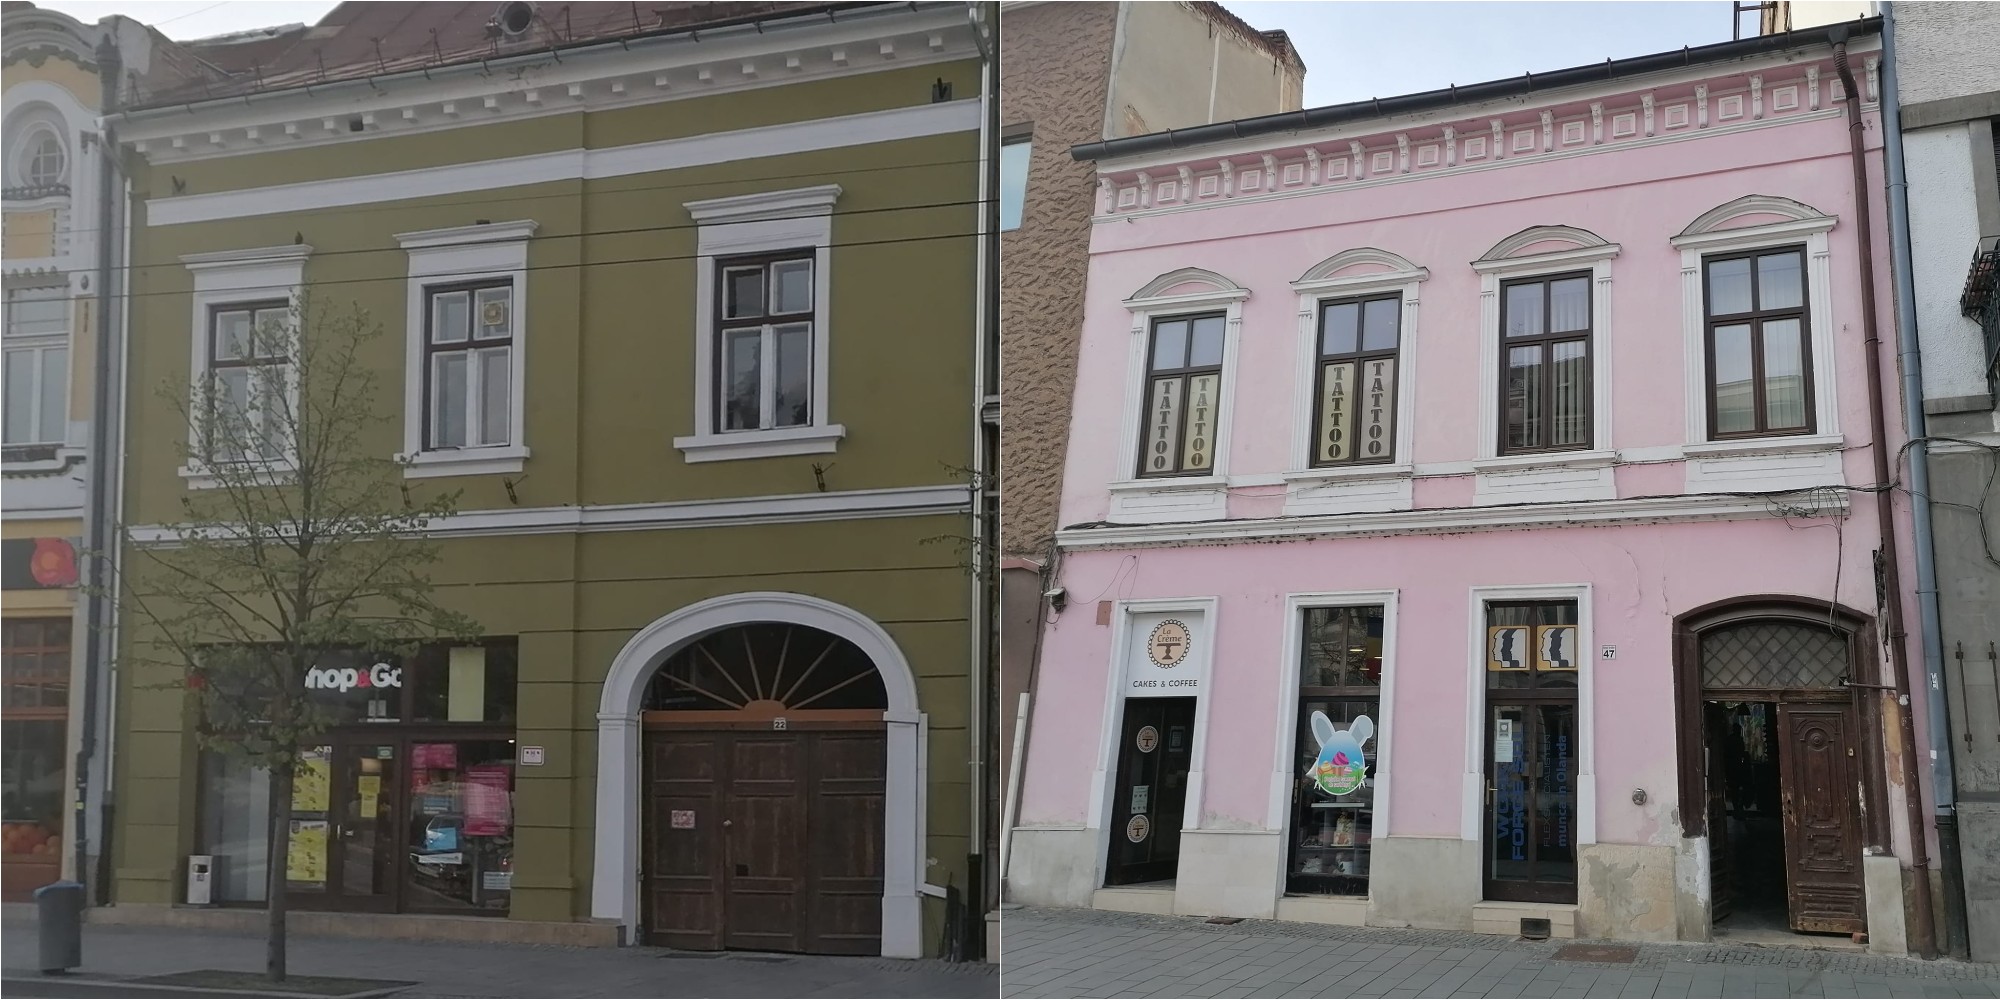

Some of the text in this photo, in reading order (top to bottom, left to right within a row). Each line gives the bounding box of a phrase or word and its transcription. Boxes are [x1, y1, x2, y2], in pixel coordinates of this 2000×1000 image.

[1154, 381, 1173, 469] TATTOO
[1191, 378, 1209, 466] TATTOO
[1328, 367, 1345, 458] TATTOO
[1368, 362, 1384, 455] TATTOO
[305, 663, 402, 692] hop&Go
[1133, 680, 1157, 688] CAKES
[1603, 649, 1614, 658] 47
[775, 721, 785, 729] 22
[1556, 735, 1566, 782] Olanda
[1512, 780, 1524, 860] FORCE
